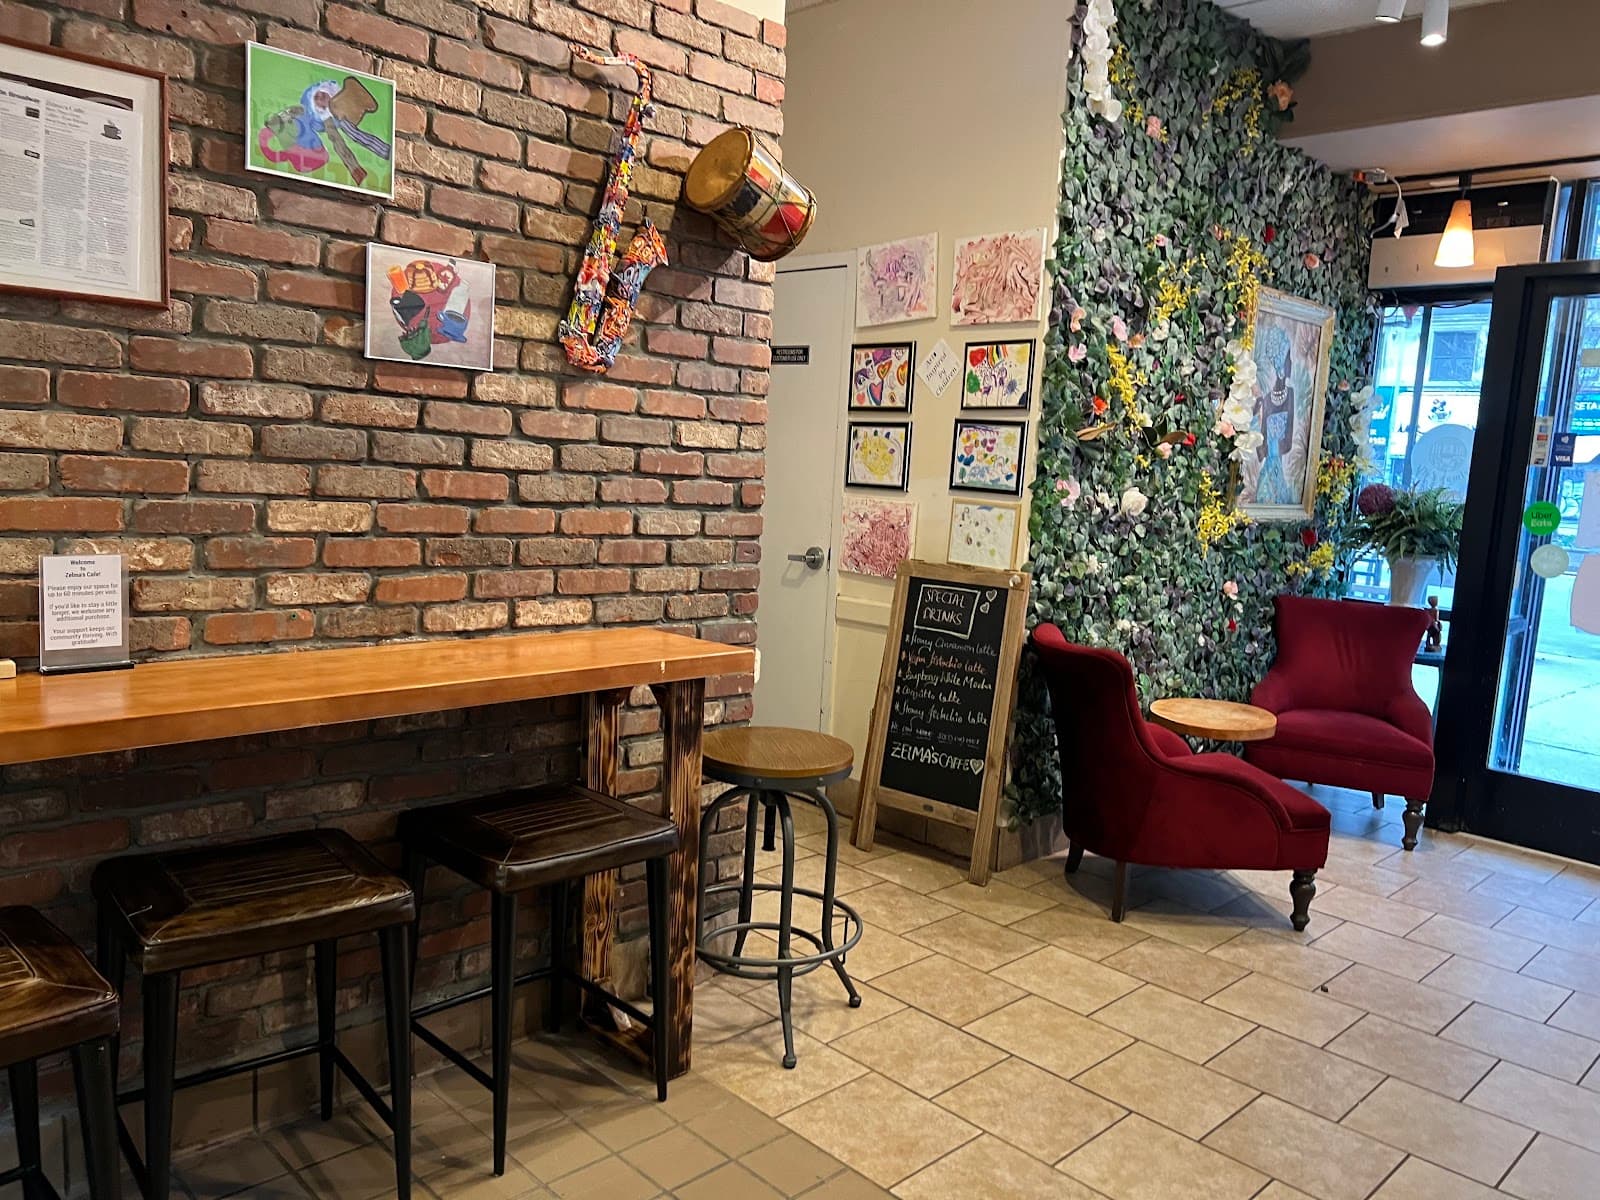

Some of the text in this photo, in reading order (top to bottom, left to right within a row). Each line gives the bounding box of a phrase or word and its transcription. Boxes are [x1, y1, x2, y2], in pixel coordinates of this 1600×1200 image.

[935, 367, 957, 396] Children
[1530, 519, 1552, 528] Eats
[1531, 511, 1552, 519] Uber
[925, 589, 965, 608] SPECIAL
[923, 607, 962, 625] DRINKS
[910, 630, 933, 654] Honey
[962, 675, 992, 690] Mocha
[890, 741, 970, 771] ZELMA'S CAFFE
